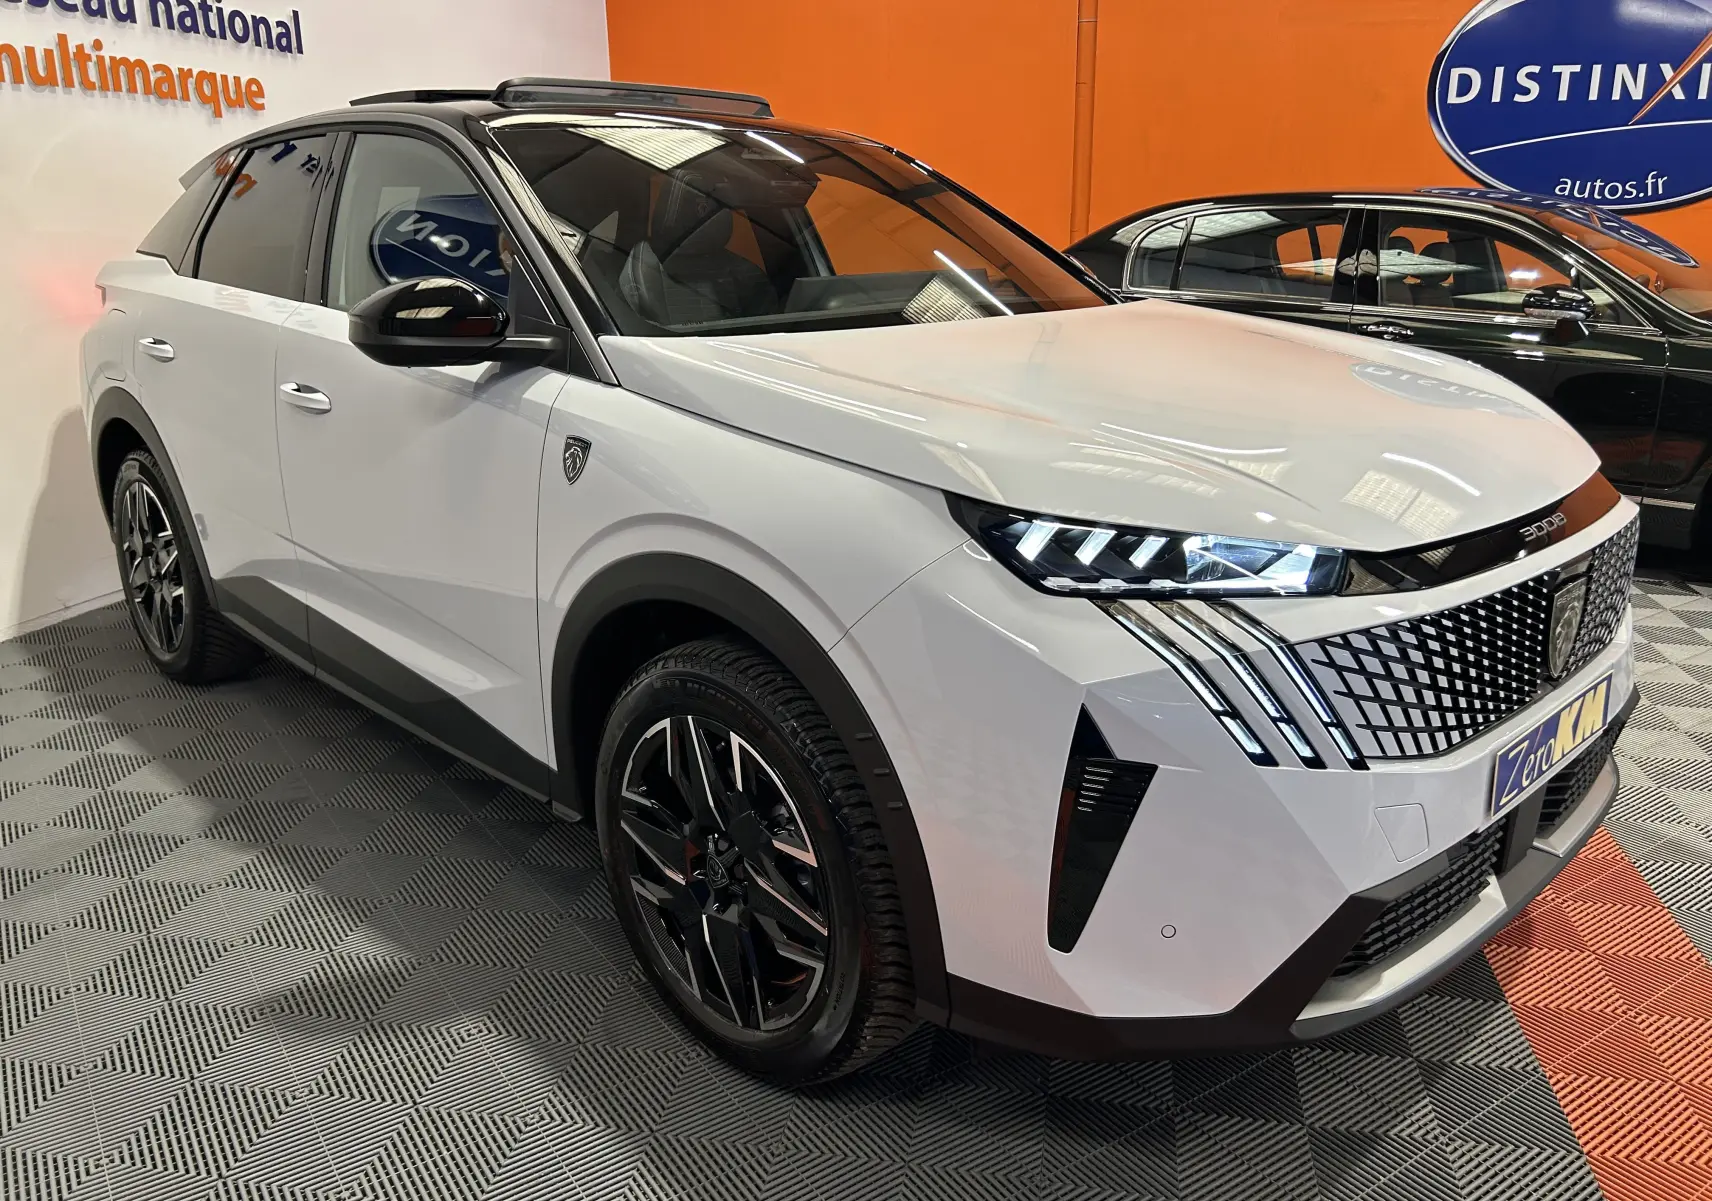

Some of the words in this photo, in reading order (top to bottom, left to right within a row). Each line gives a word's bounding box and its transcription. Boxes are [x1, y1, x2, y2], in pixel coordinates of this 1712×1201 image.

[149, 0, 304, 55] national
[1554, 170, 1668, 200] autos.fr
[1519, 512, 1567, 541] 3008
